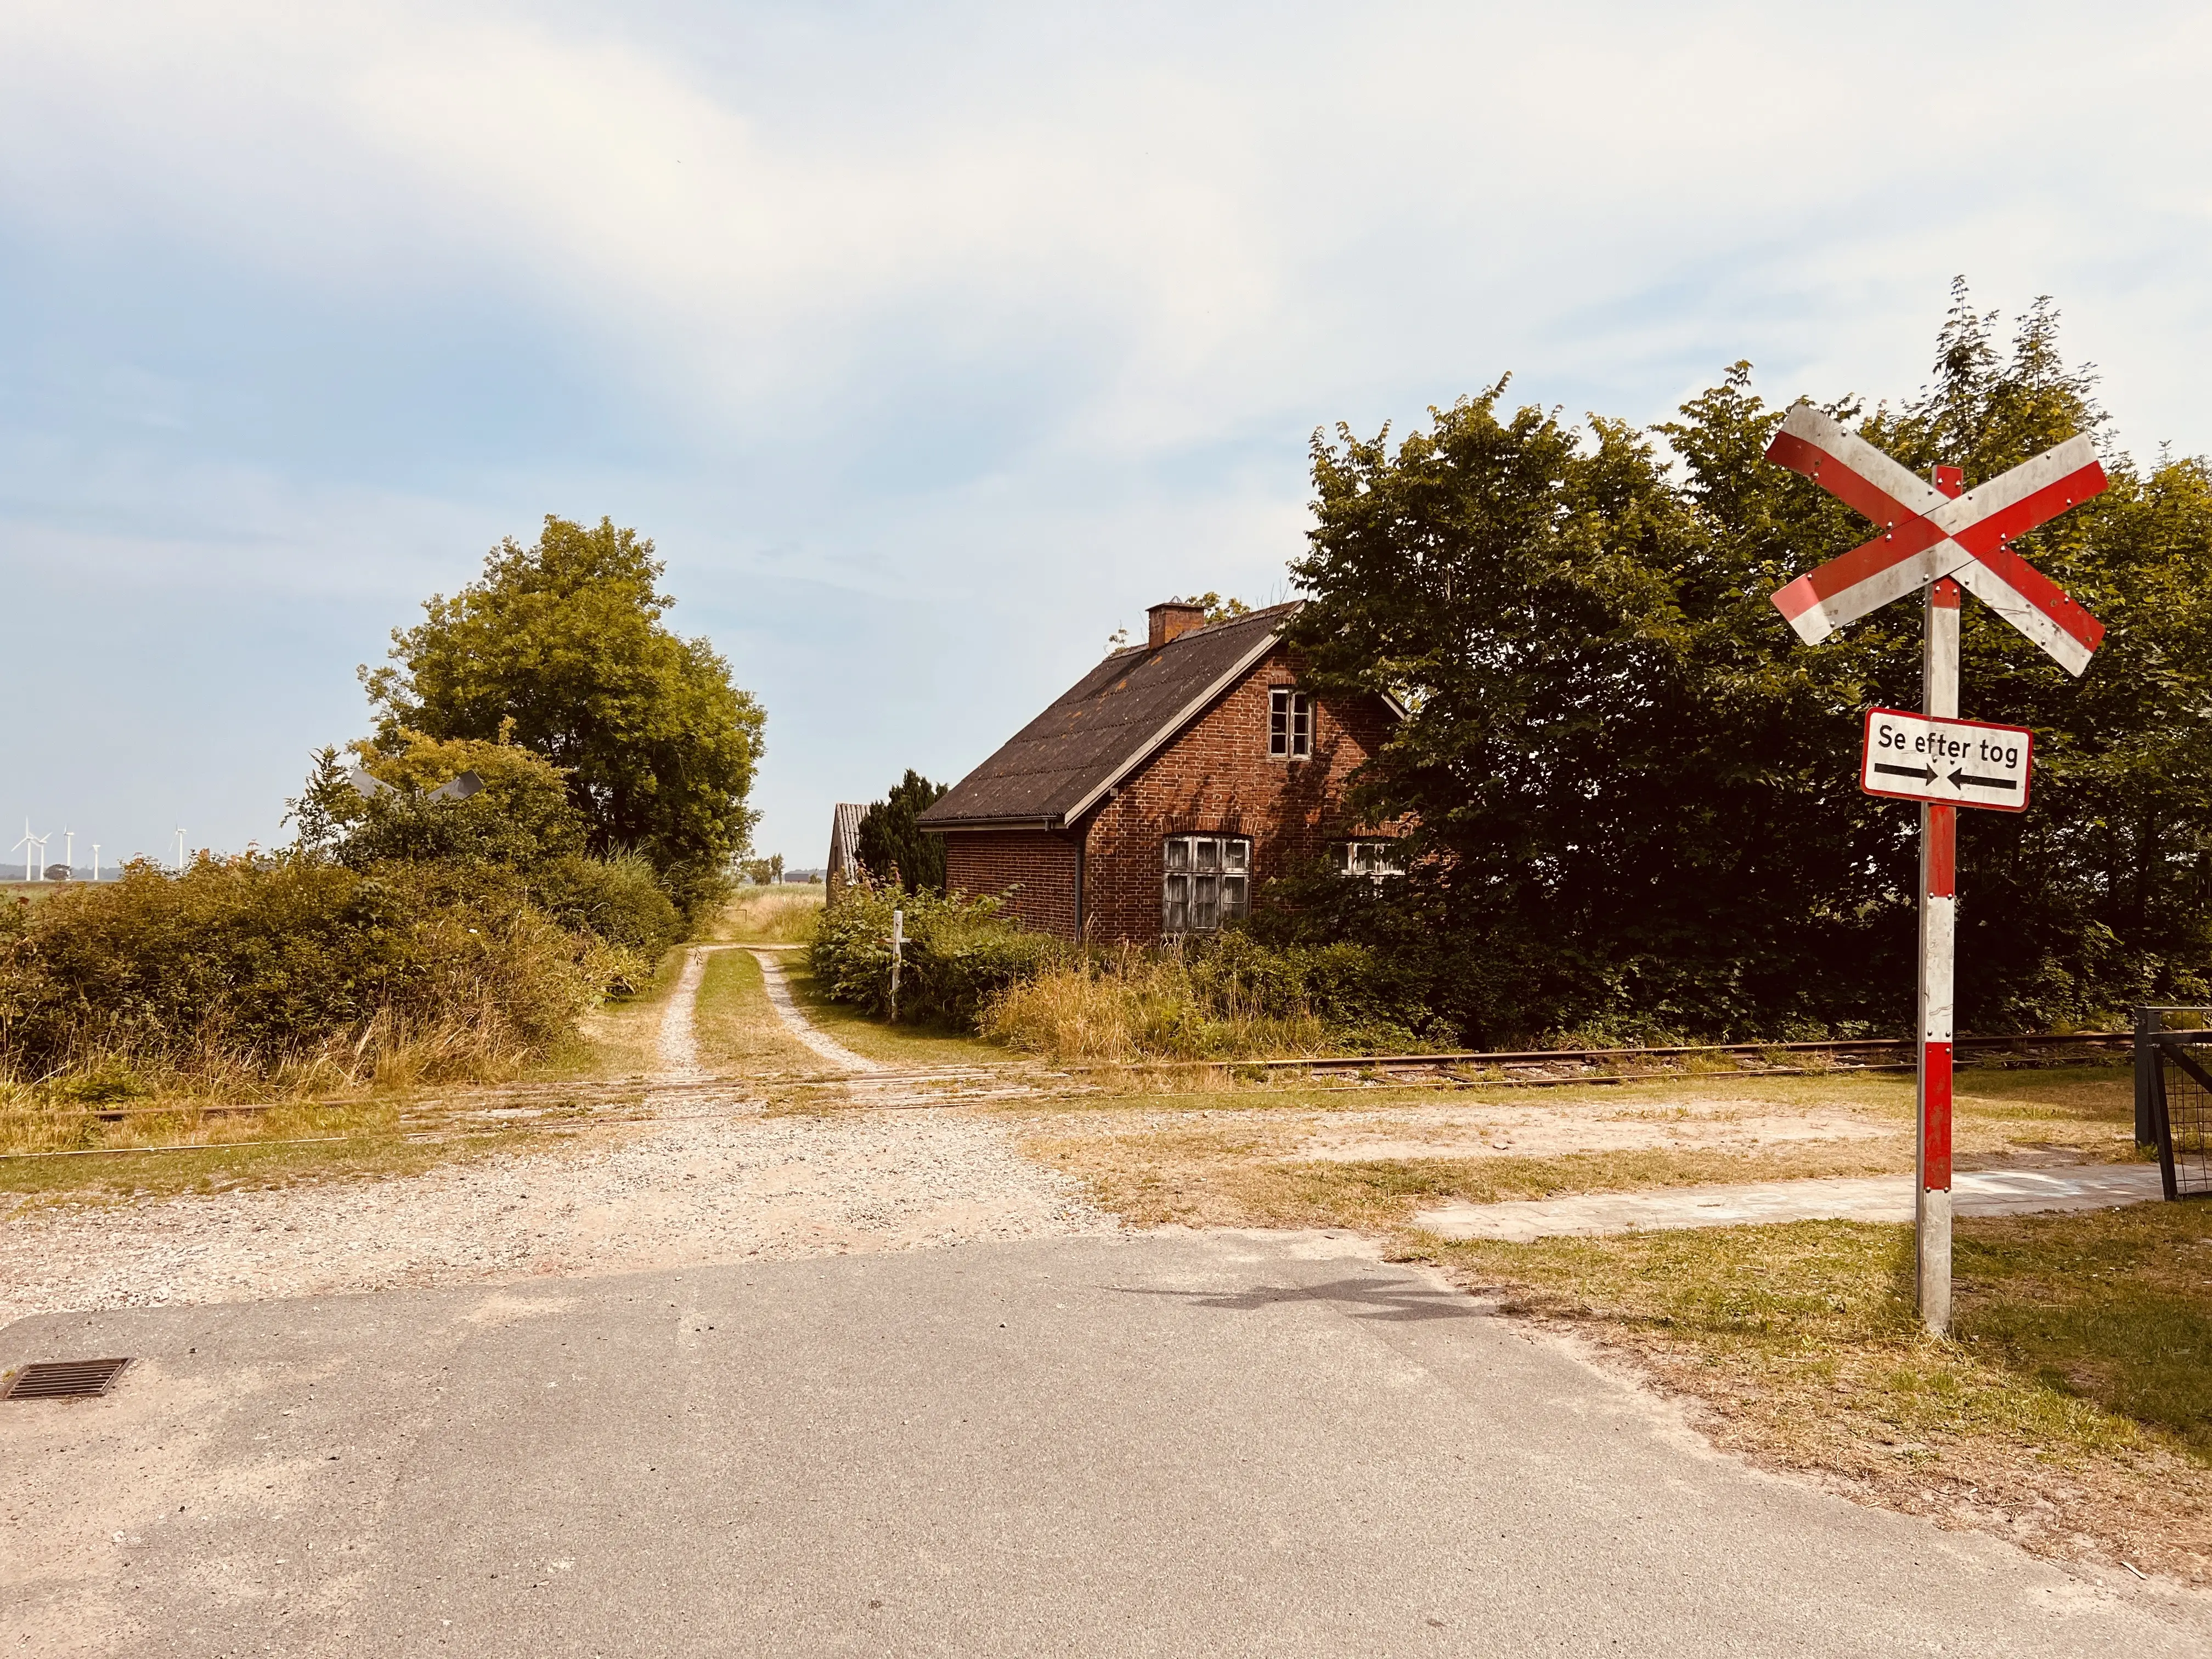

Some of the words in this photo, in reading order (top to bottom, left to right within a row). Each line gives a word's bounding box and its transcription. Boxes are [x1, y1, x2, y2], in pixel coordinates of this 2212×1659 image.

[1878, 725, 1906, 750] Se
[1915, 732, 1971, 758] efter
[1979, 740, 2018, 769] tog
